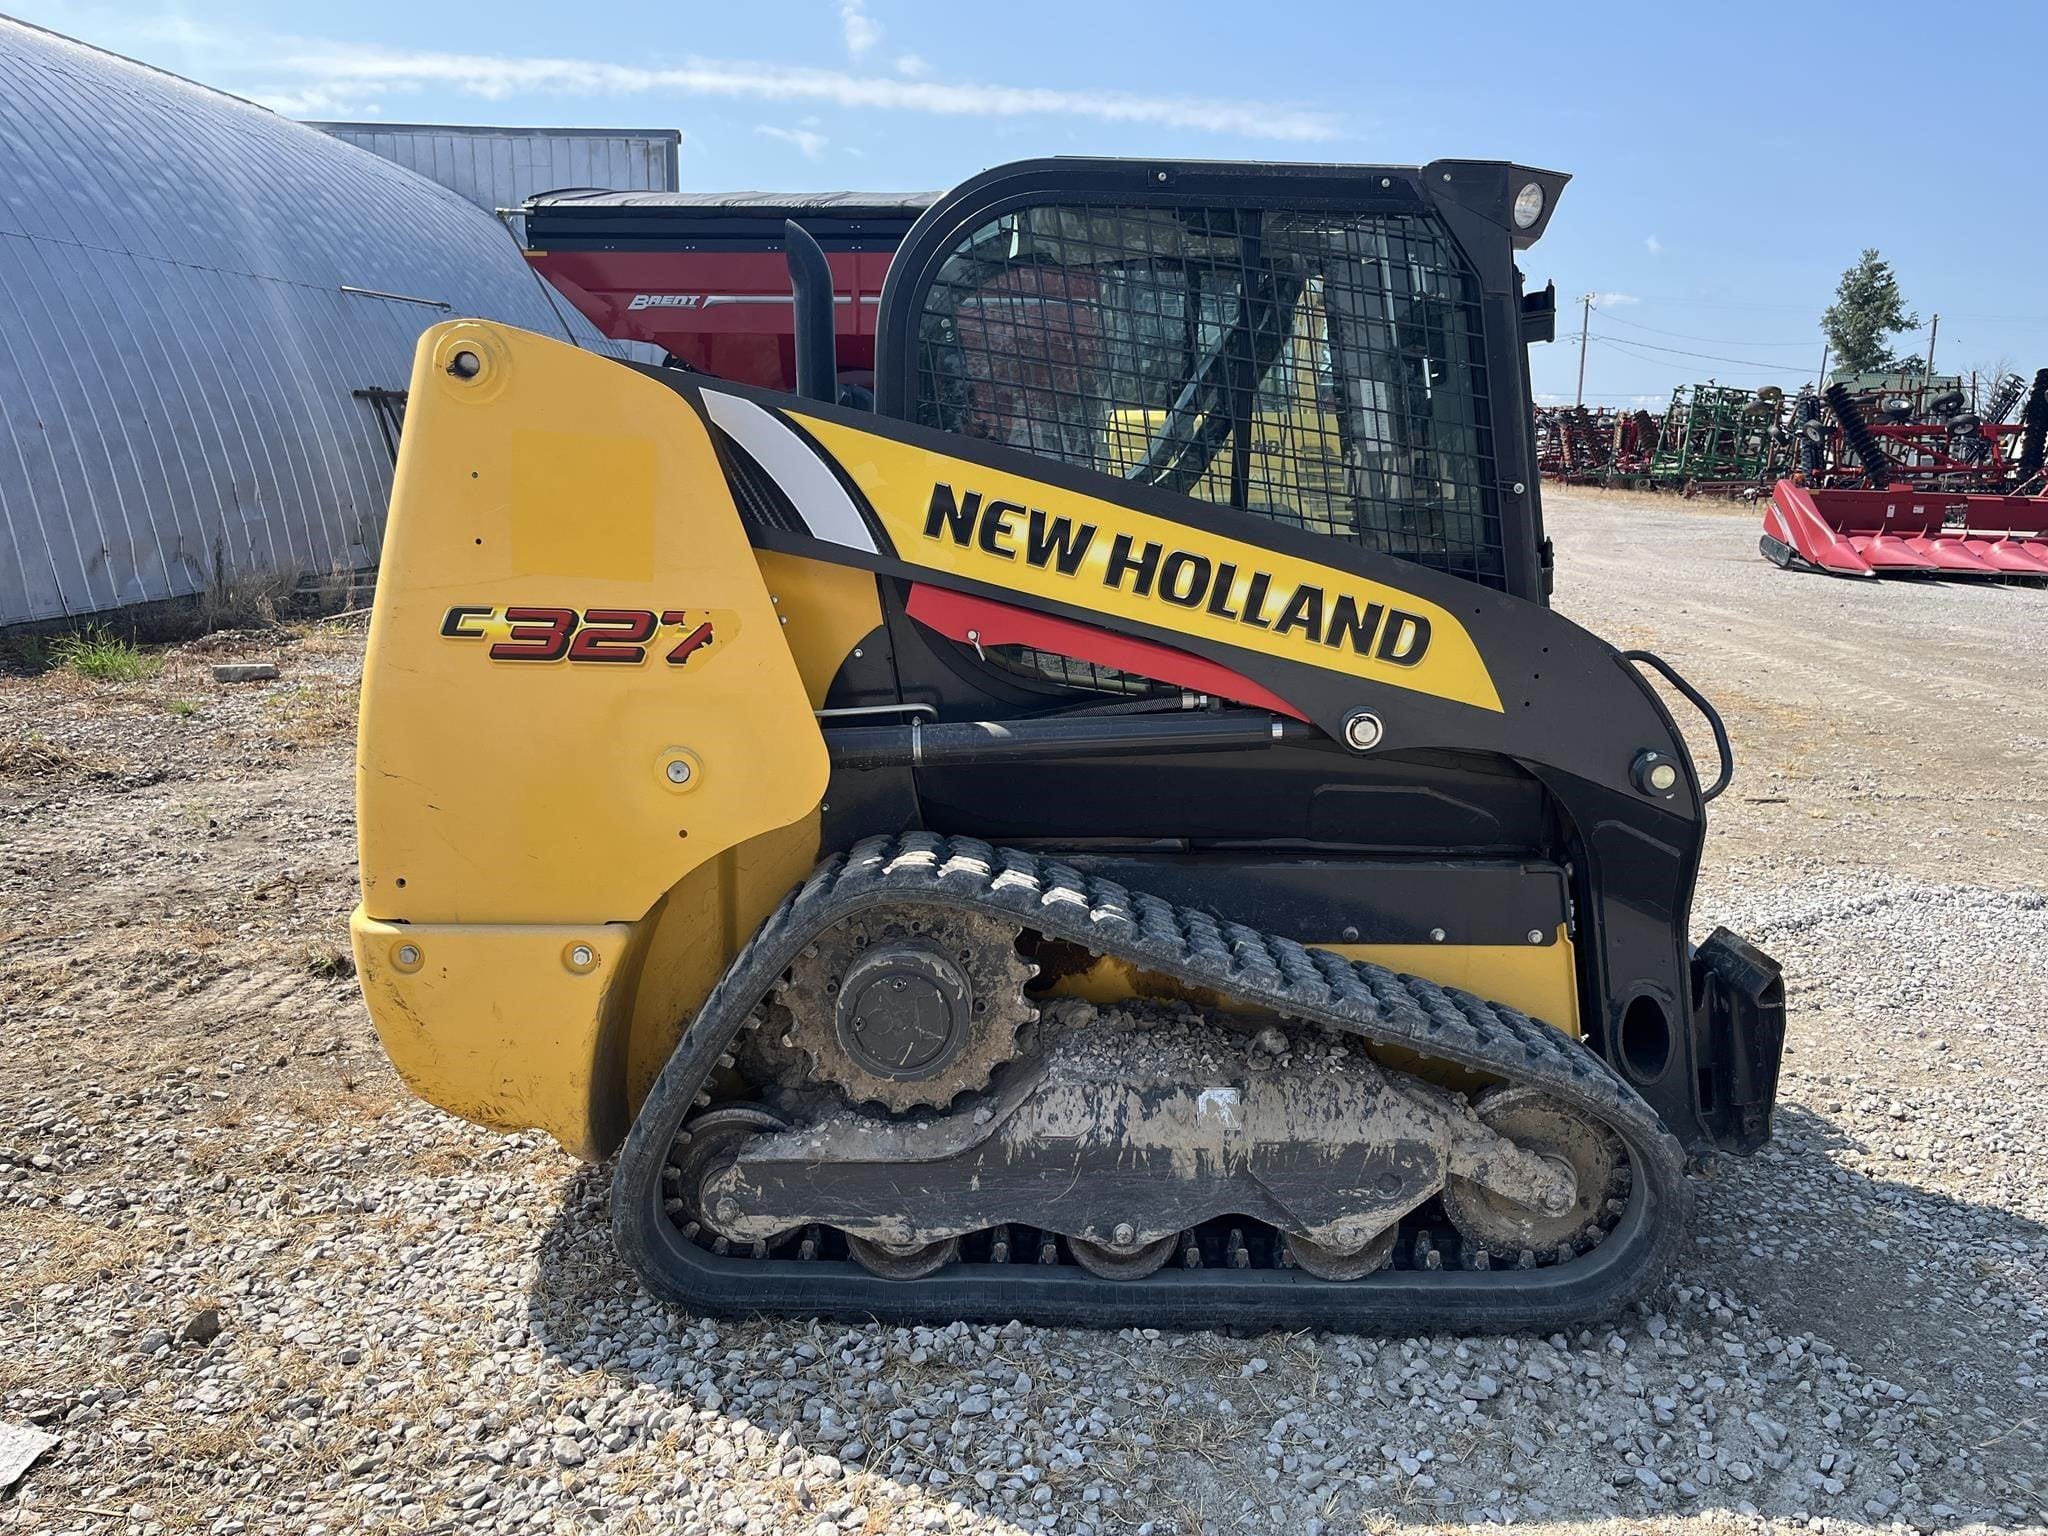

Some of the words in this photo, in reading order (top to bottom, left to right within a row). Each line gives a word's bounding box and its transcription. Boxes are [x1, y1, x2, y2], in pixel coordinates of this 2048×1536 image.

[627, 294, 701, 310] BRENT
[922, 481, 1098, 577] NEW
[1103, 532, 1433, 668] HOLLAND
